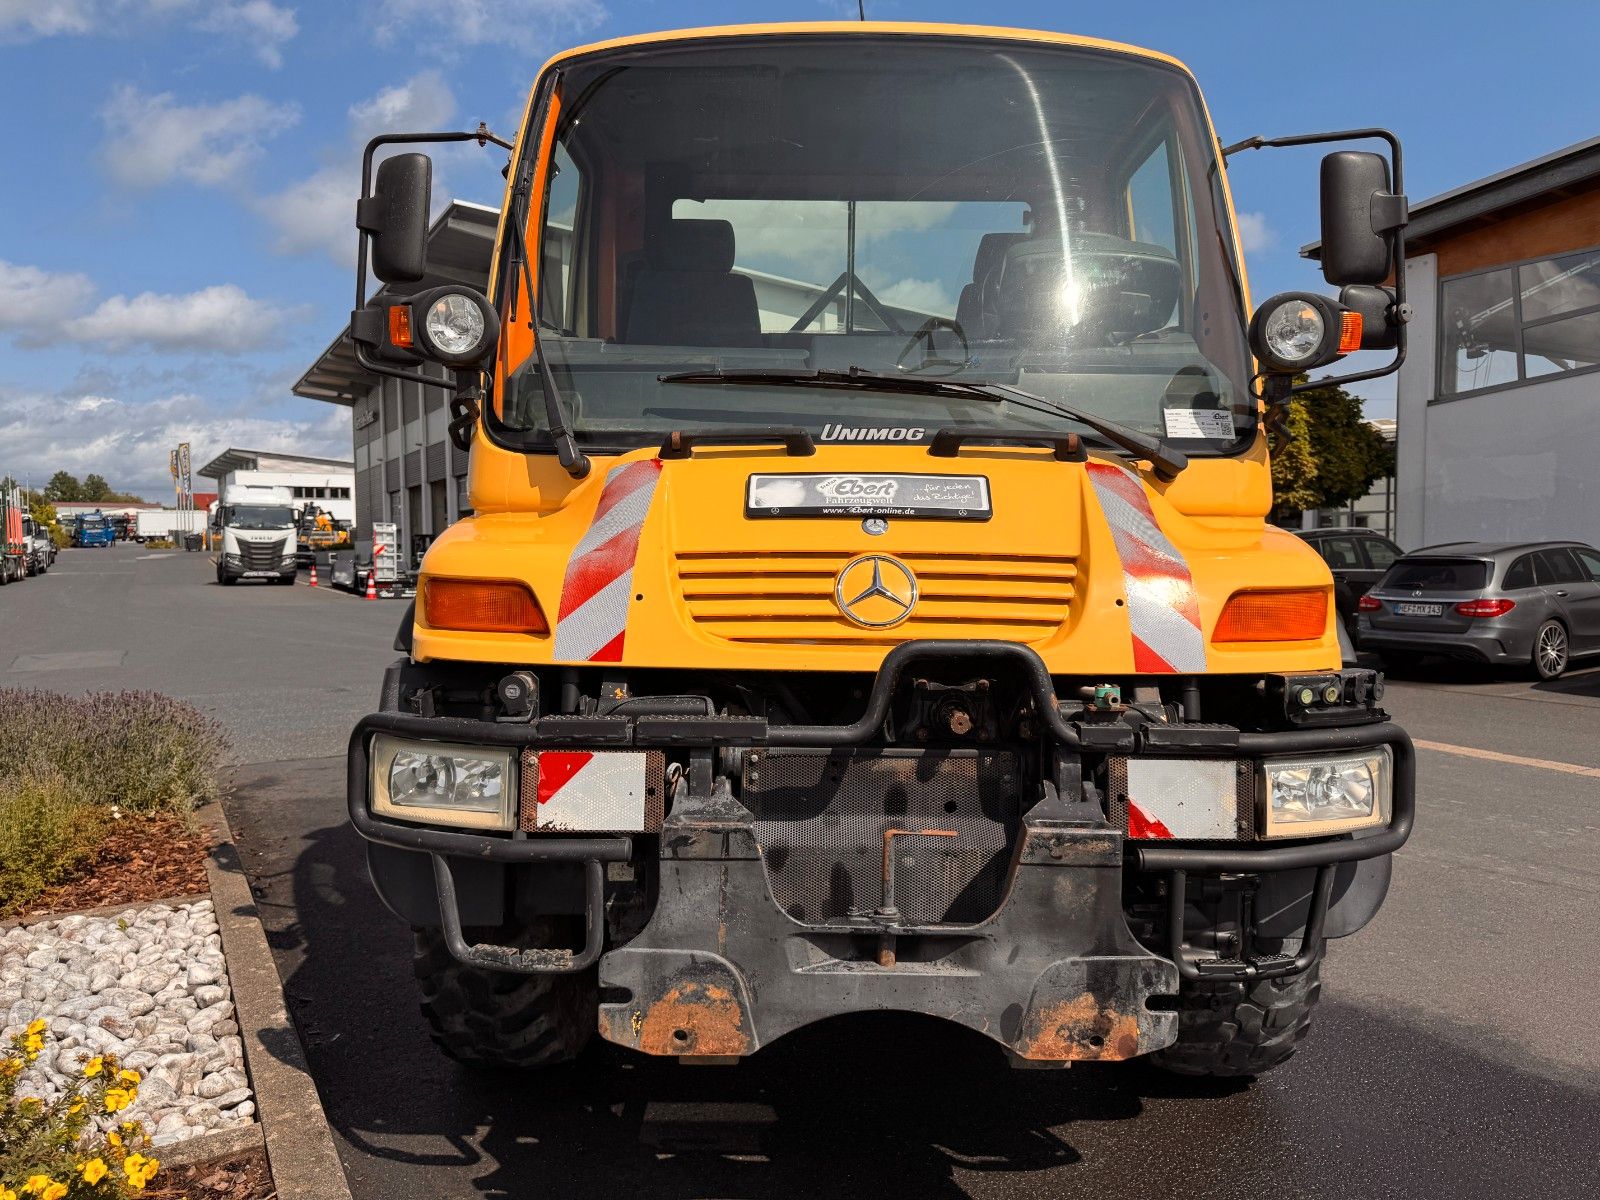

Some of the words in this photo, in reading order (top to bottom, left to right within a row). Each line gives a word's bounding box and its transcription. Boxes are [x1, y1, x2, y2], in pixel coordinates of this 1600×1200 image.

[820, 423, 926, 441] UNIMOG
[835, 479, 895, 496] Ebert
[943, 482, 972, 492] jeden
[825, 496, 894, 506] Fahrzeugwelt
[913, 493, 931, 501] das
